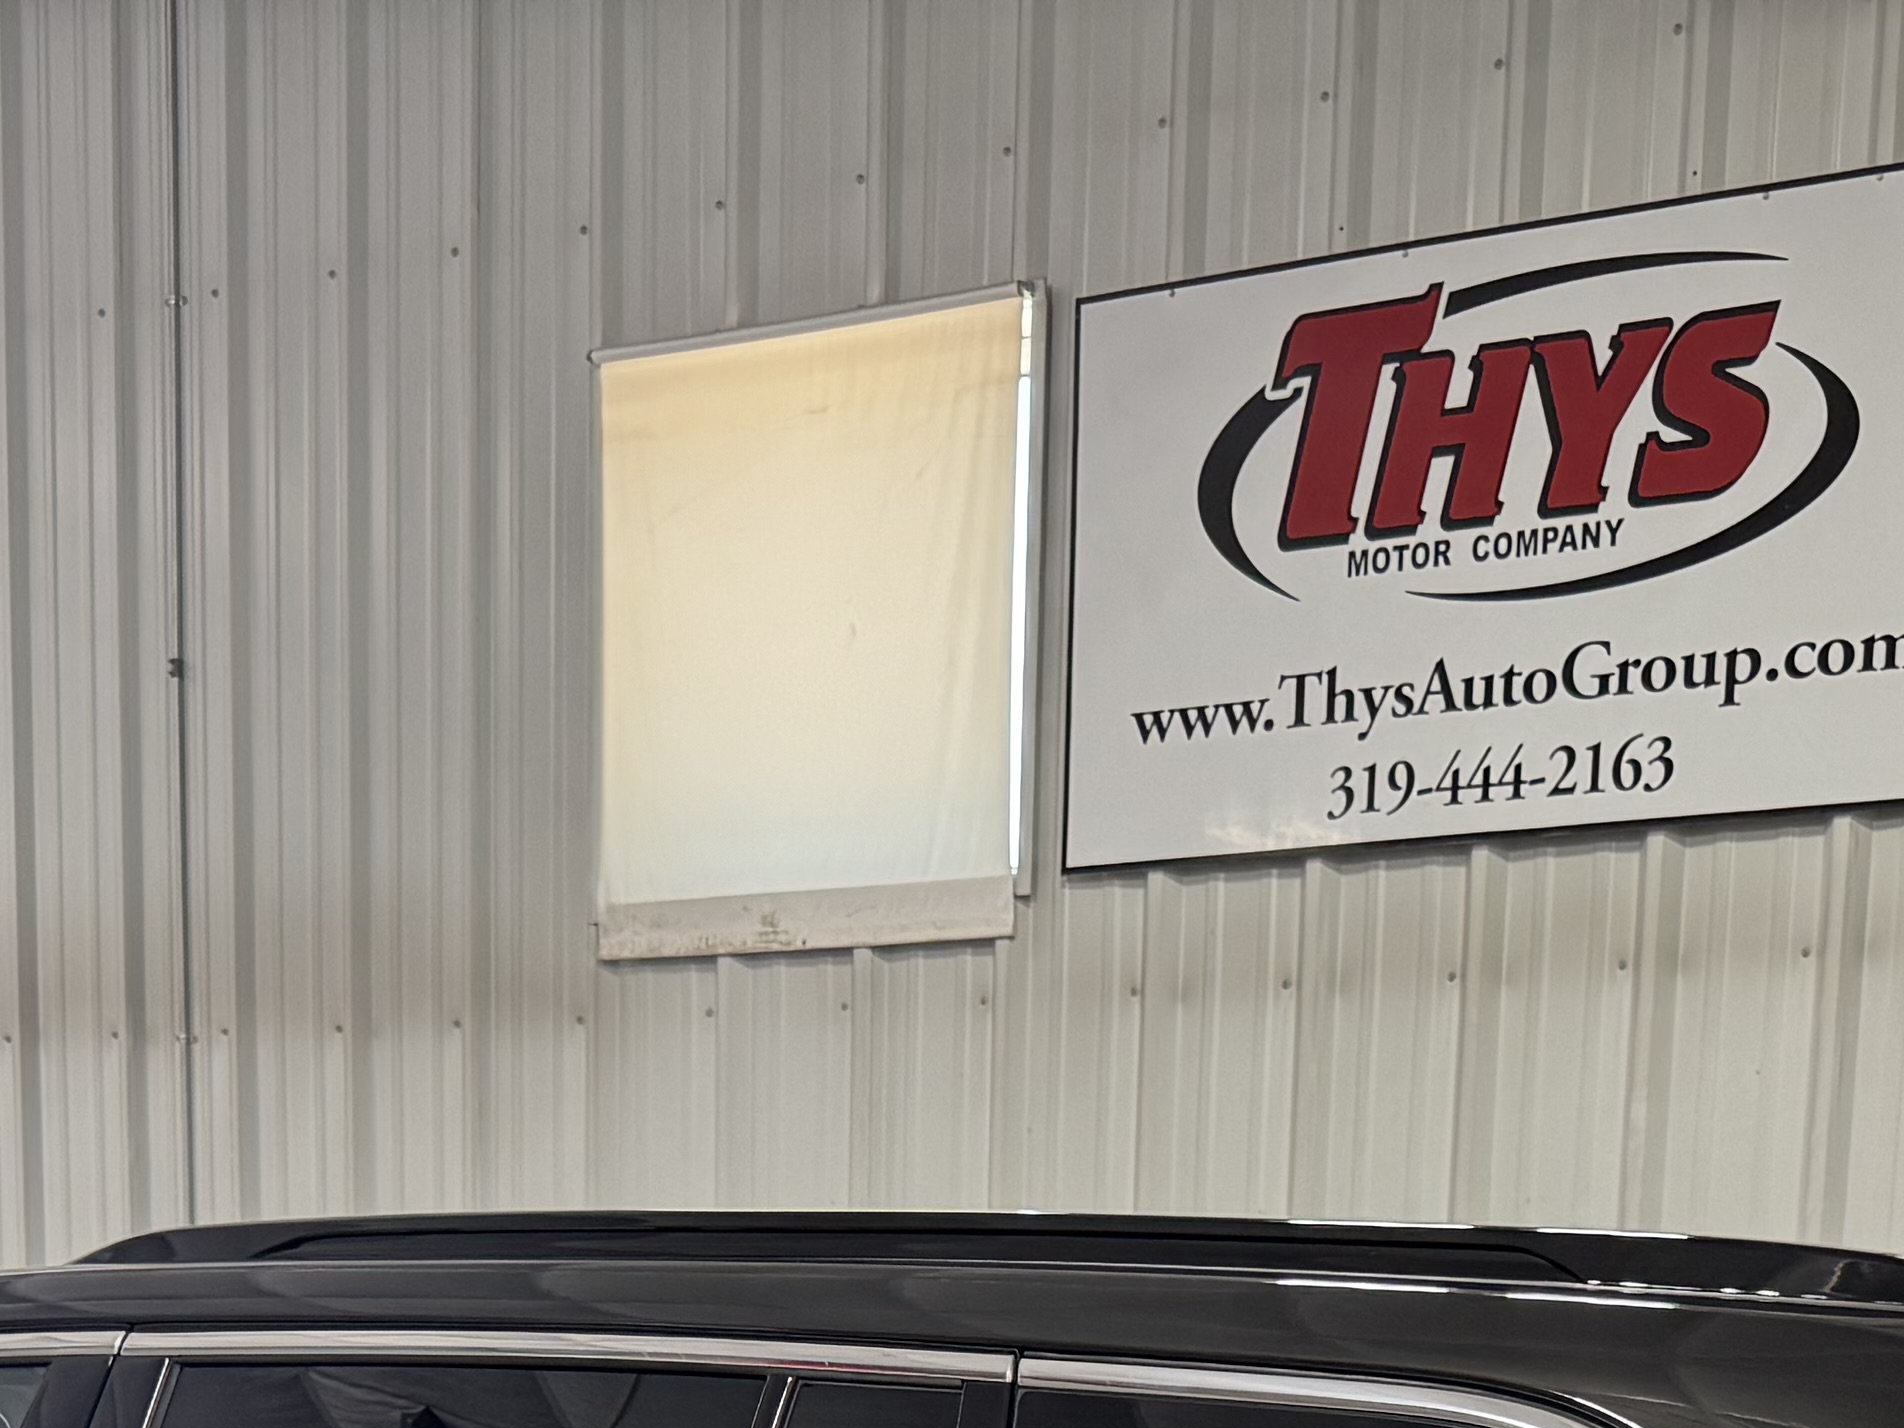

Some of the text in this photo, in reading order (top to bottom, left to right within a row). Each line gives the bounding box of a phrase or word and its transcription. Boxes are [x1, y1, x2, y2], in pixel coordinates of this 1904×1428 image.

[1276, 281, 1782, 551] THYS
[1347, 518, 1624, 577] MOTOR COMPANY
[1327, 734, 1676, 820] 319-444-2163
